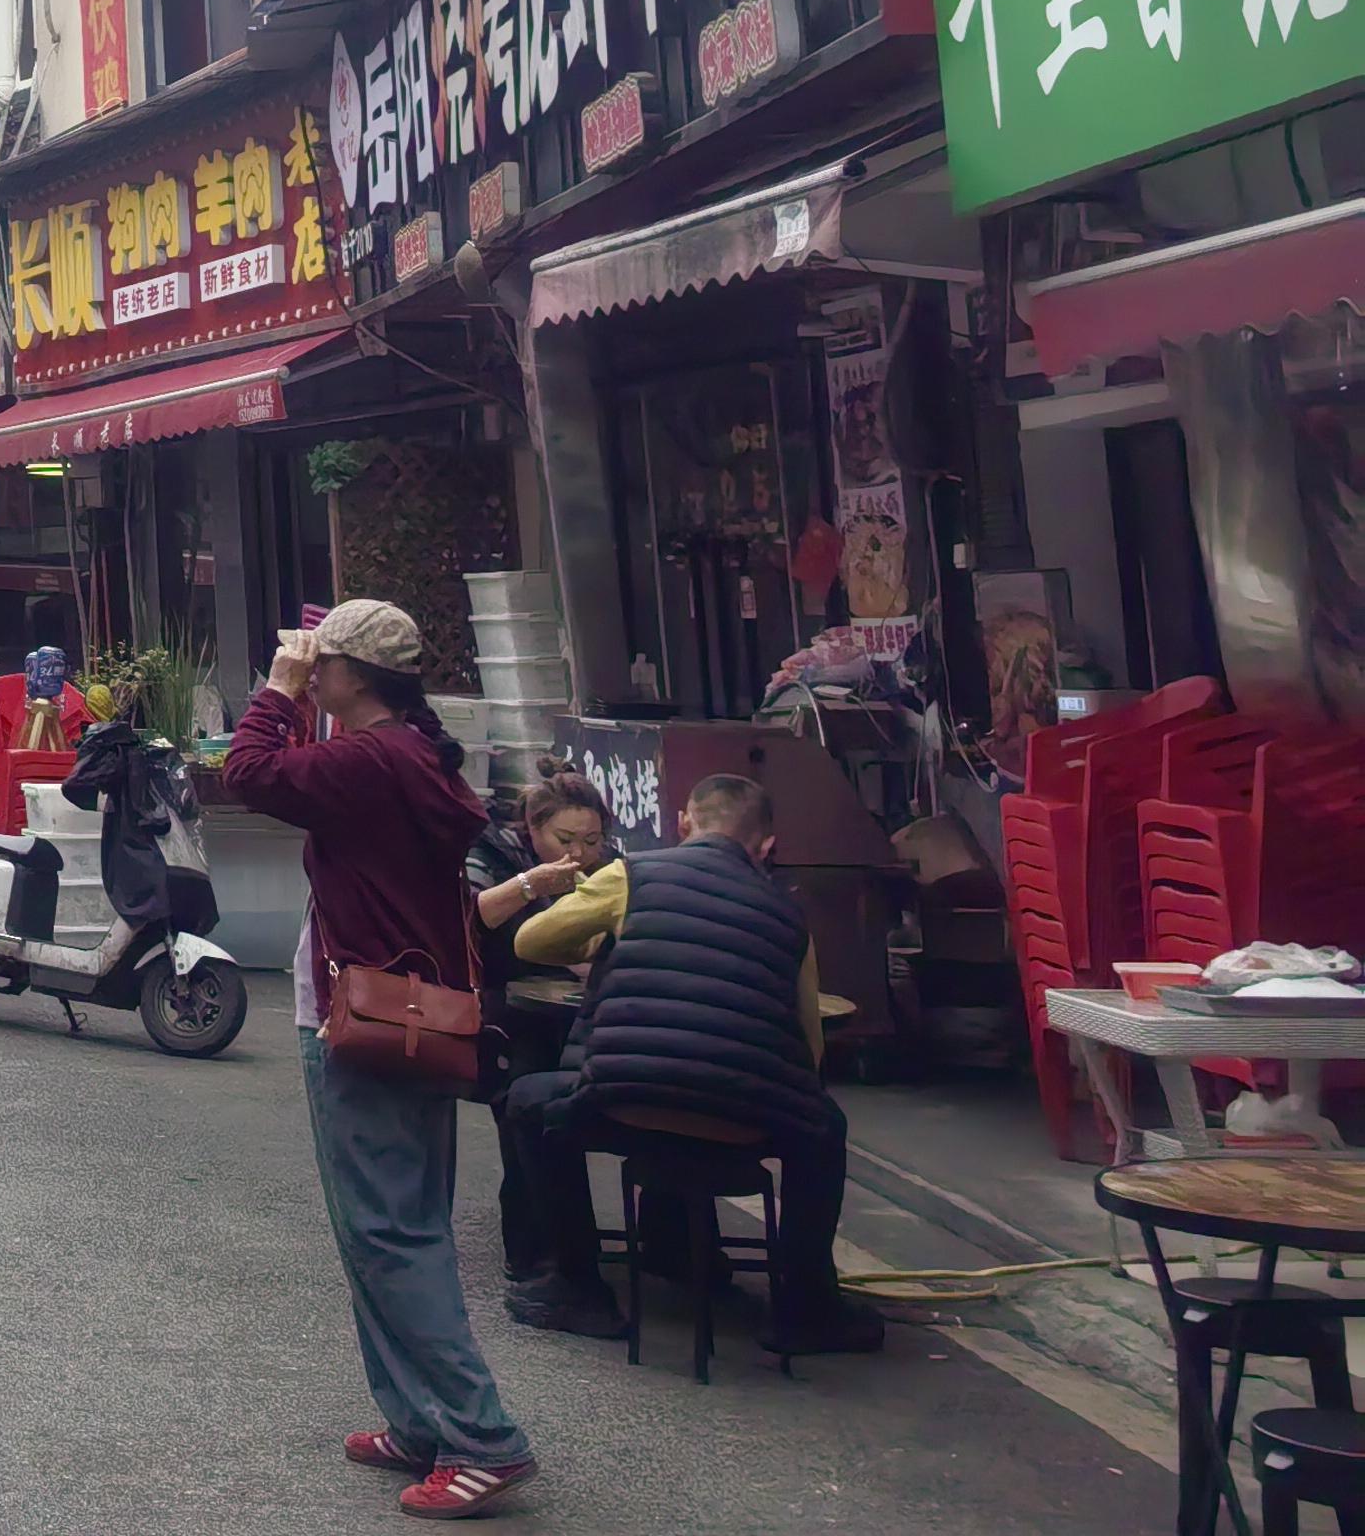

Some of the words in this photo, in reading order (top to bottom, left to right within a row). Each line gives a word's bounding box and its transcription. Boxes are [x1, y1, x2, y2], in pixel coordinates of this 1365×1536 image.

[10, 202, 97, 350] 长顺
[107, 171, 179, 275] 狗肉
[195, 137, 273, 245] 羊肉
[284, 107, 325, 284] 老店
[116, 281, 175, 319] 传统老店
[204, 253, 269, 296] 新鲜食材
[565, 745, 661, 838] 阳烧烤
